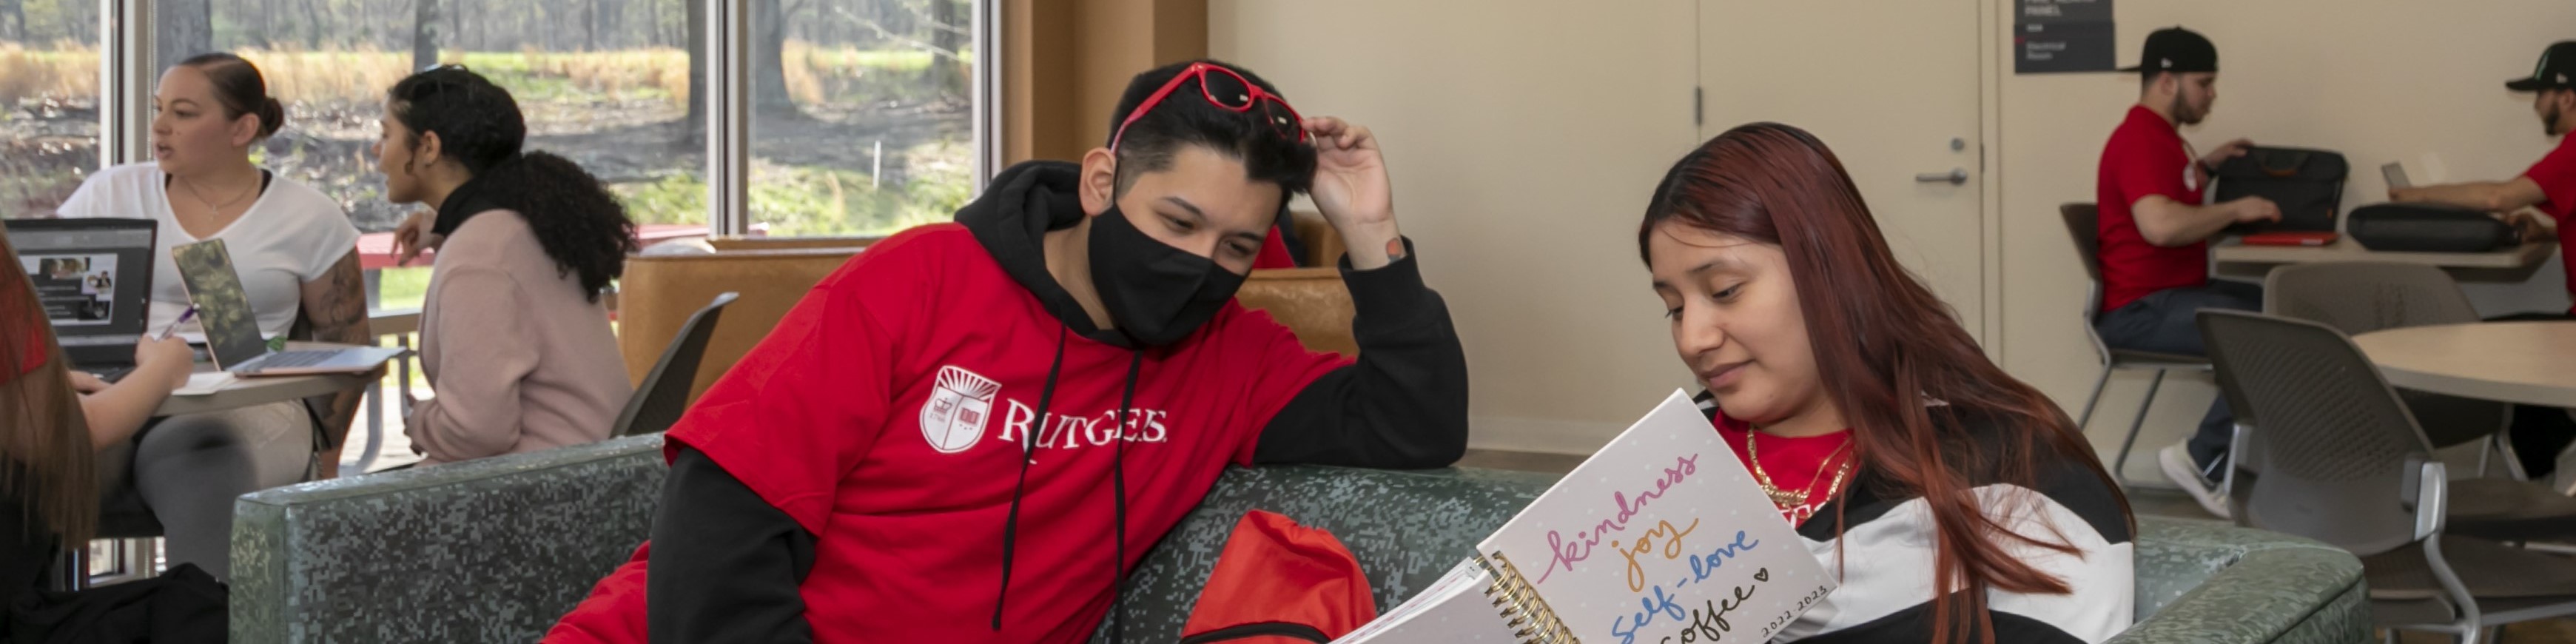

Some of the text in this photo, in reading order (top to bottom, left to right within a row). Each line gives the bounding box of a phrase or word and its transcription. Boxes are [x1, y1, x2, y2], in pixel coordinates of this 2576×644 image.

[1537, 453, 1699, 585] kindness
[1611, 517, 1699, 593] joy
[1612, 530, 1759, 644] self-love
[1761, 585, 1828, 638] 2022-2023
